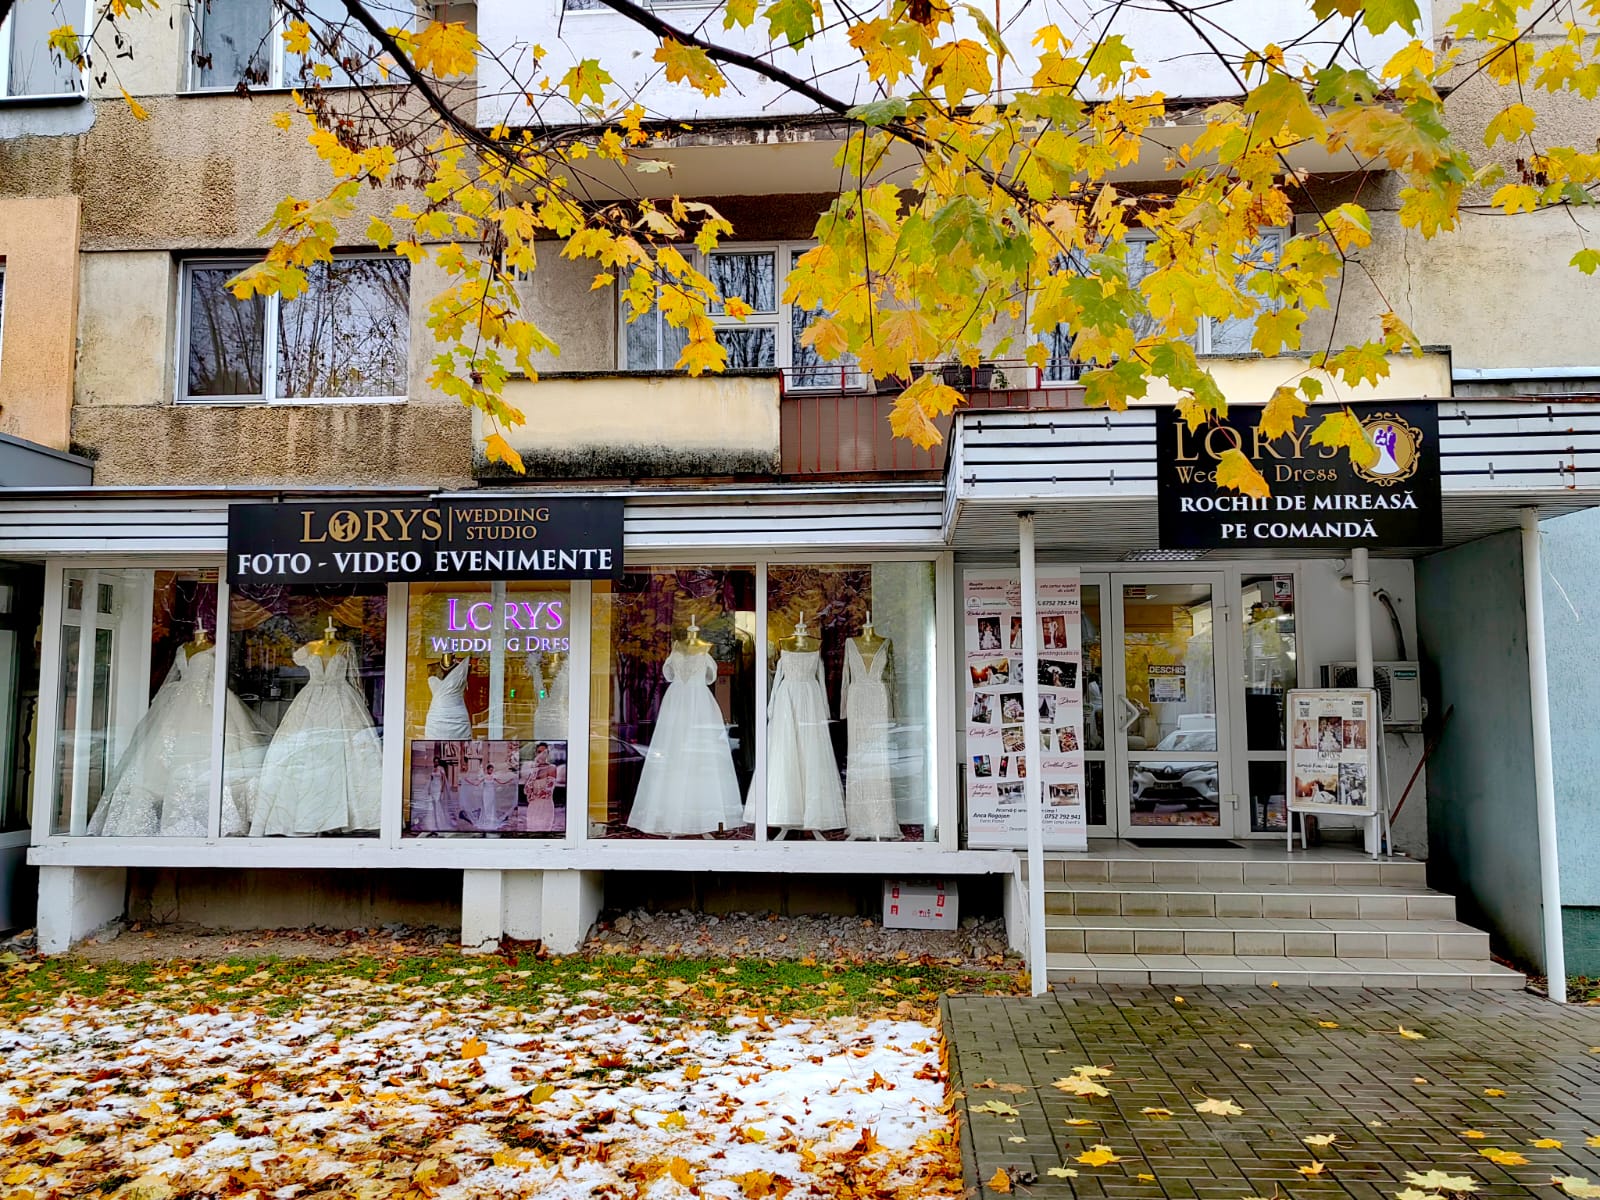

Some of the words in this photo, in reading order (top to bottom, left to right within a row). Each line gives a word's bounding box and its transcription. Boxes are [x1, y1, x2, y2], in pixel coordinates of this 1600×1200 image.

[1275, 464, 1338, 482] Dress
[1180, 496, 1267, 512] ROCHII
[1276, 495, 1306, 512] DE
[1313, 490, 1418, 511] MIREASĂ
[454, 508, 550, 523] WEDDING
[300, 508, 442, 543] LORYS
[466, 525, 538, 541] STUDIO
[1220, 523, 1247, 539] PE
[1253, 518, 1378, 538] COMANDĂ
[237, 553, 311, 575] FOTO
[332, 551, 422, 573] VIDEO
[434, 549, 612, 572] EVENIMENTE
[431, 636, 520, 652] WEDDIG
[526, 636, 569, 652] DRES
[1149, 665, 1185, 674] DESCHIS
